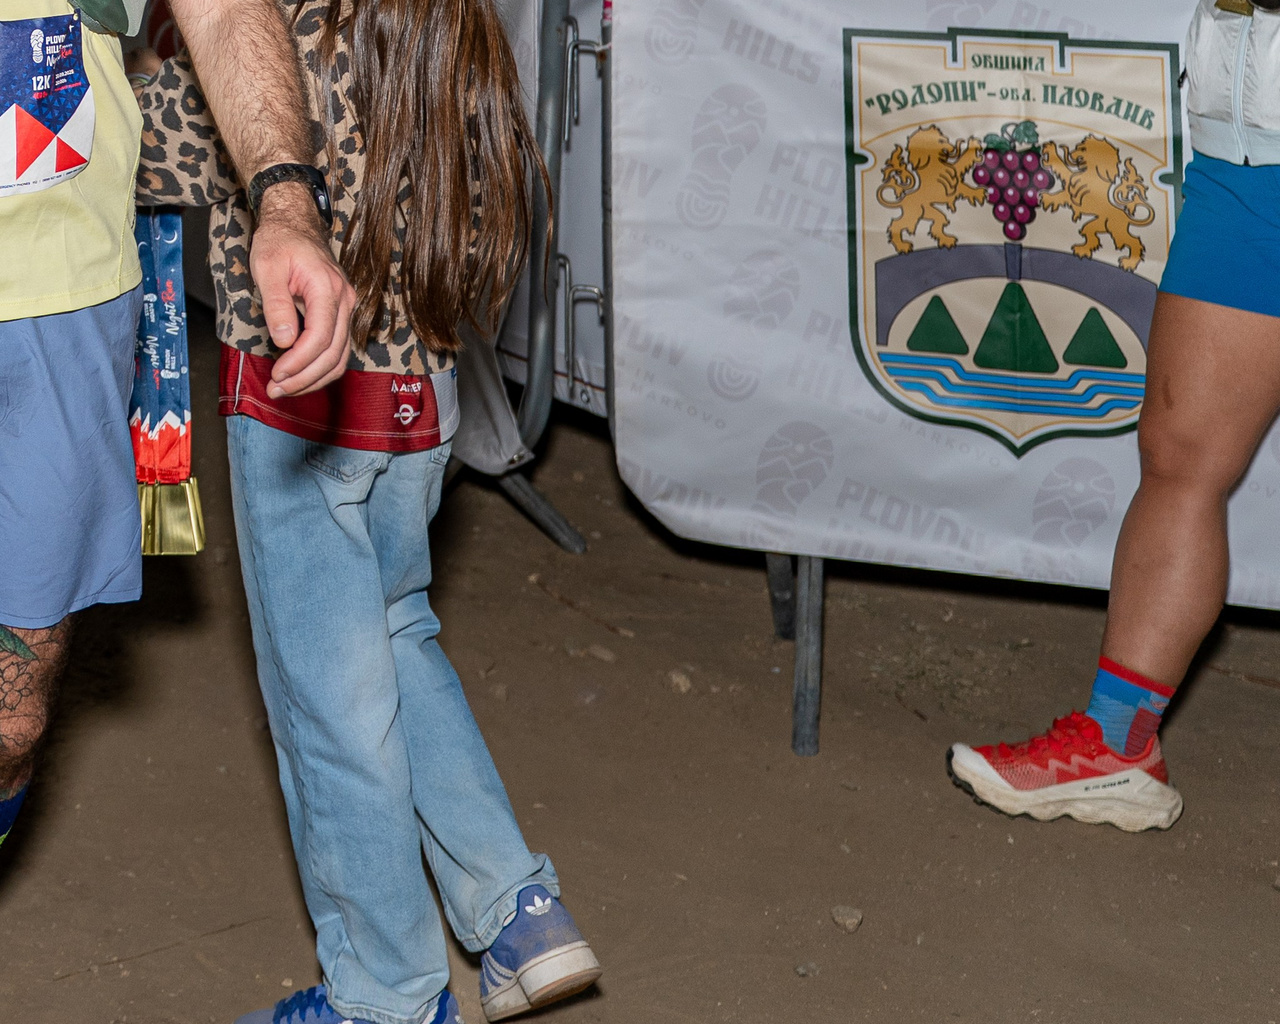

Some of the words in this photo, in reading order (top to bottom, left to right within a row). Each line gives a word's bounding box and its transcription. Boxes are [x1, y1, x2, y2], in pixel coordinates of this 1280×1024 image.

[721, 15, 821, 85] HILLS
[31, 74, 51, 91] 12K
[1042, 83, 1155, 131] ПЛОВДИВ
[161, 279, 177, 303] Run
[164, 302, 183, 335] Night
